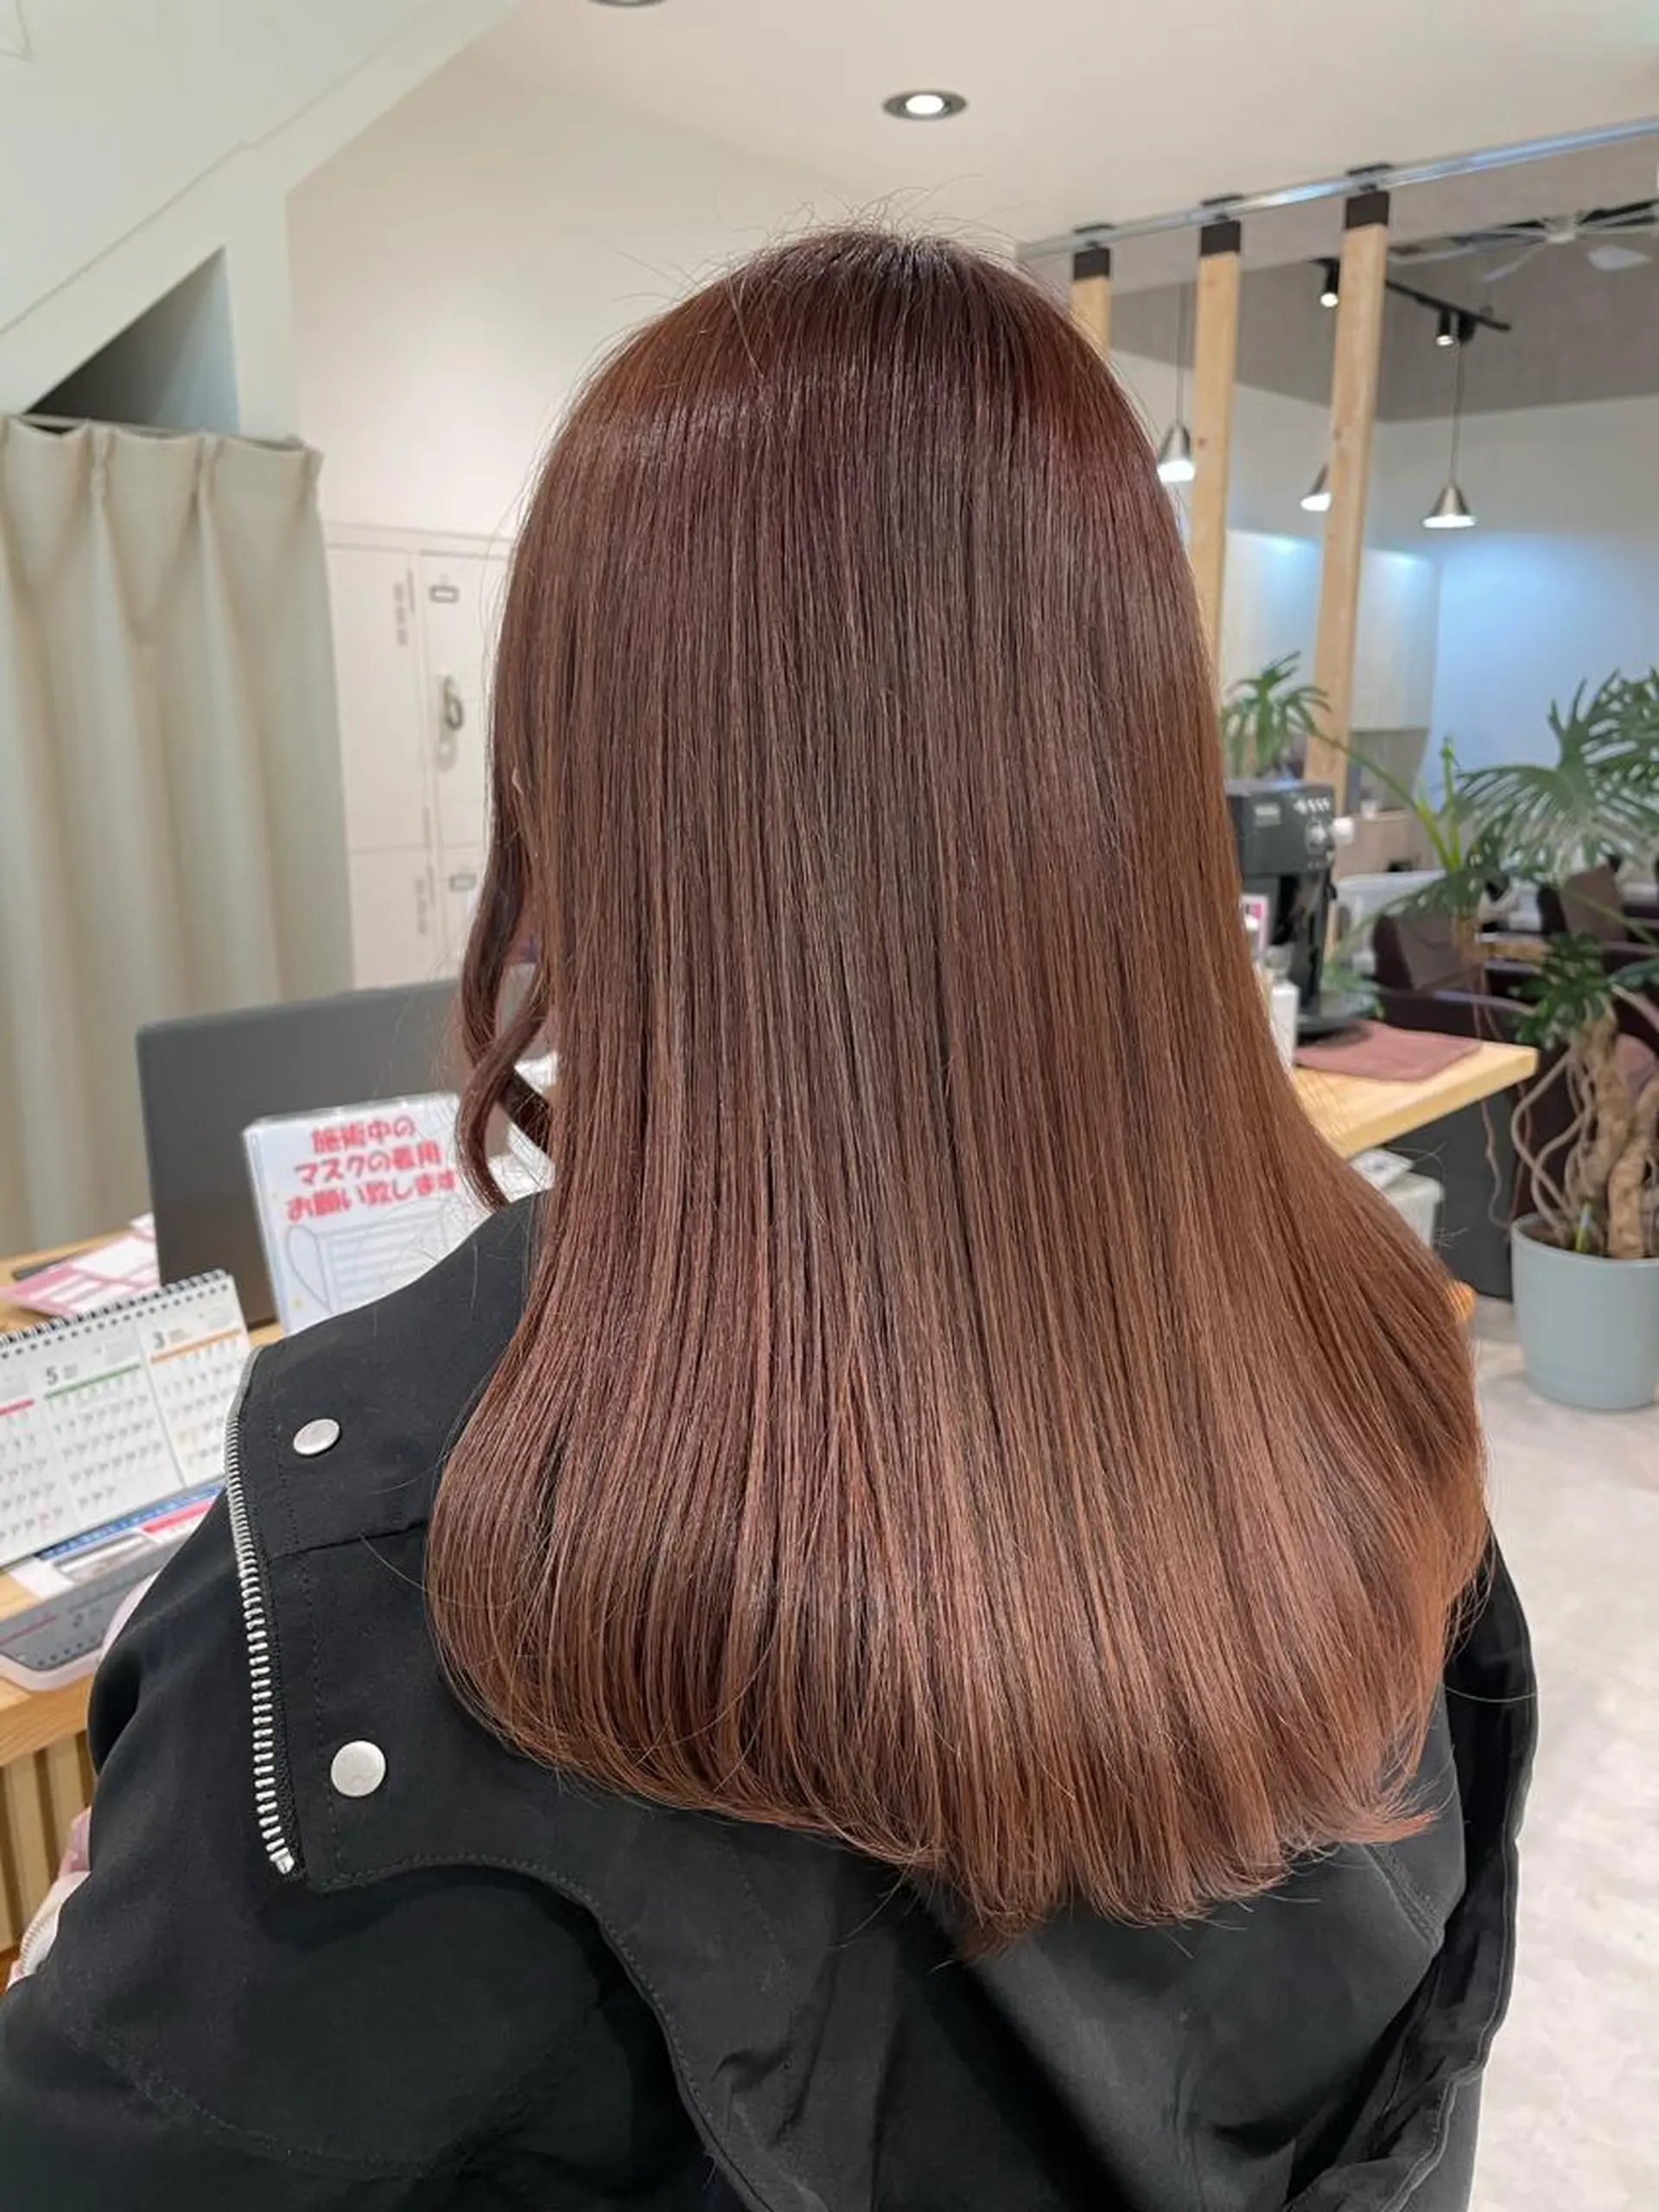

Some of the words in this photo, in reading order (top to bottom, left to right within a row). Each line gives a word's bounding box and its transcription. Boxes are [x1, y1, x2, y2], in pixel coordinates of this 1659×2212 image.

[312, 1115, 416, 1154] 施術中の
[295, 1140, 442, 1185] マスクの着用
[46, 1365, 59, 1387] 5
